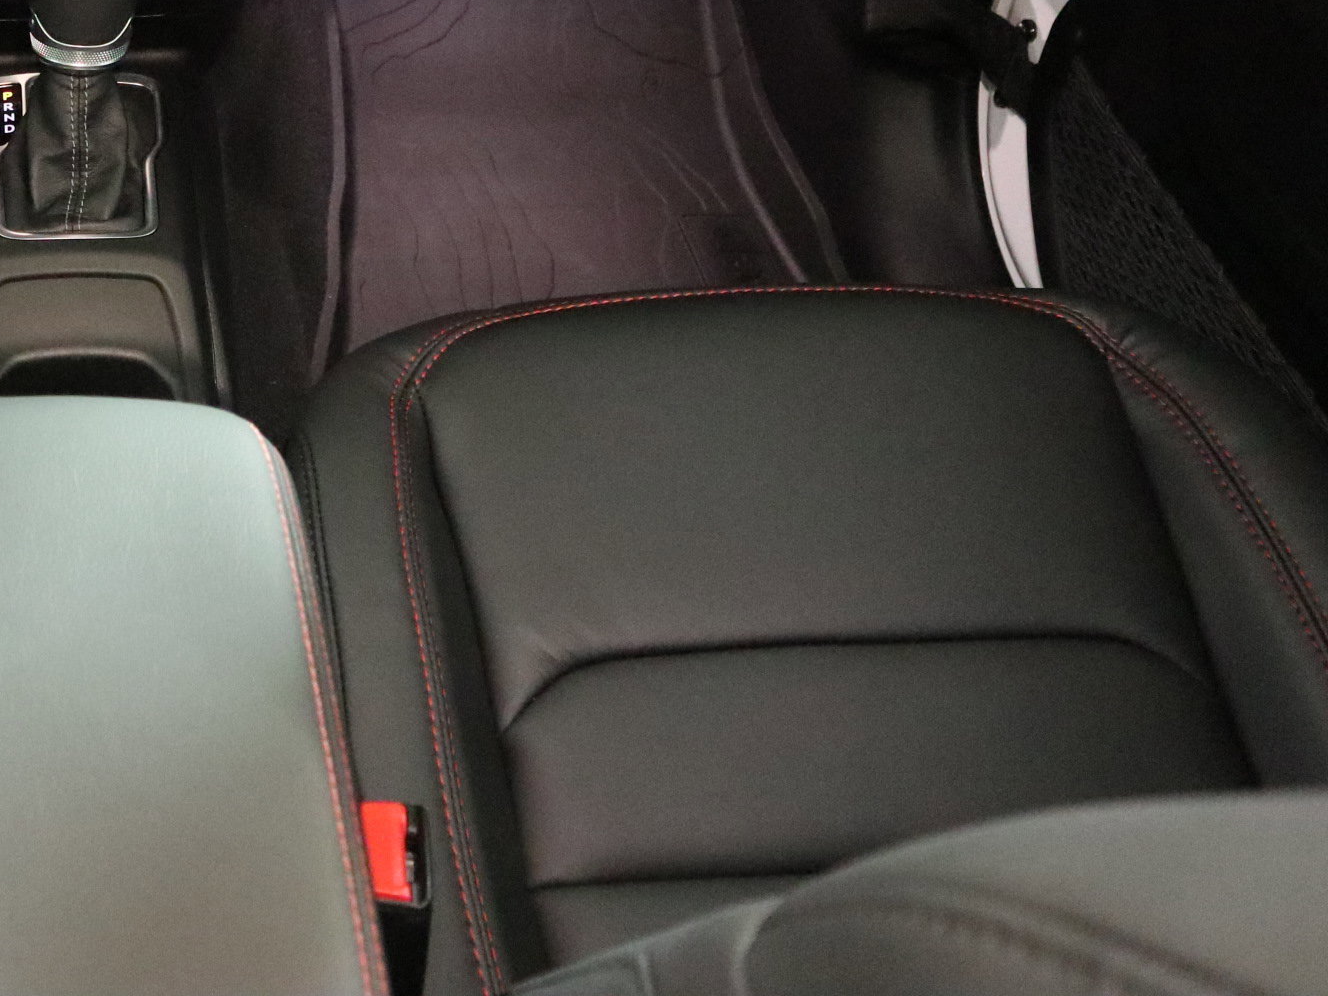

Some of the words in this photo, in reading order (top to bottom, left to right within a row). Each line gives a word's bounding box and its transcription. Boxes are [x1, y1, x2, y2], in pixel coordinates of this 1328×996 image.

[3, 91, 13, 101] P
[3, 102, 14, 111] R
[4, 113, 15, 122] N
[4, 124, 15, 134] D
